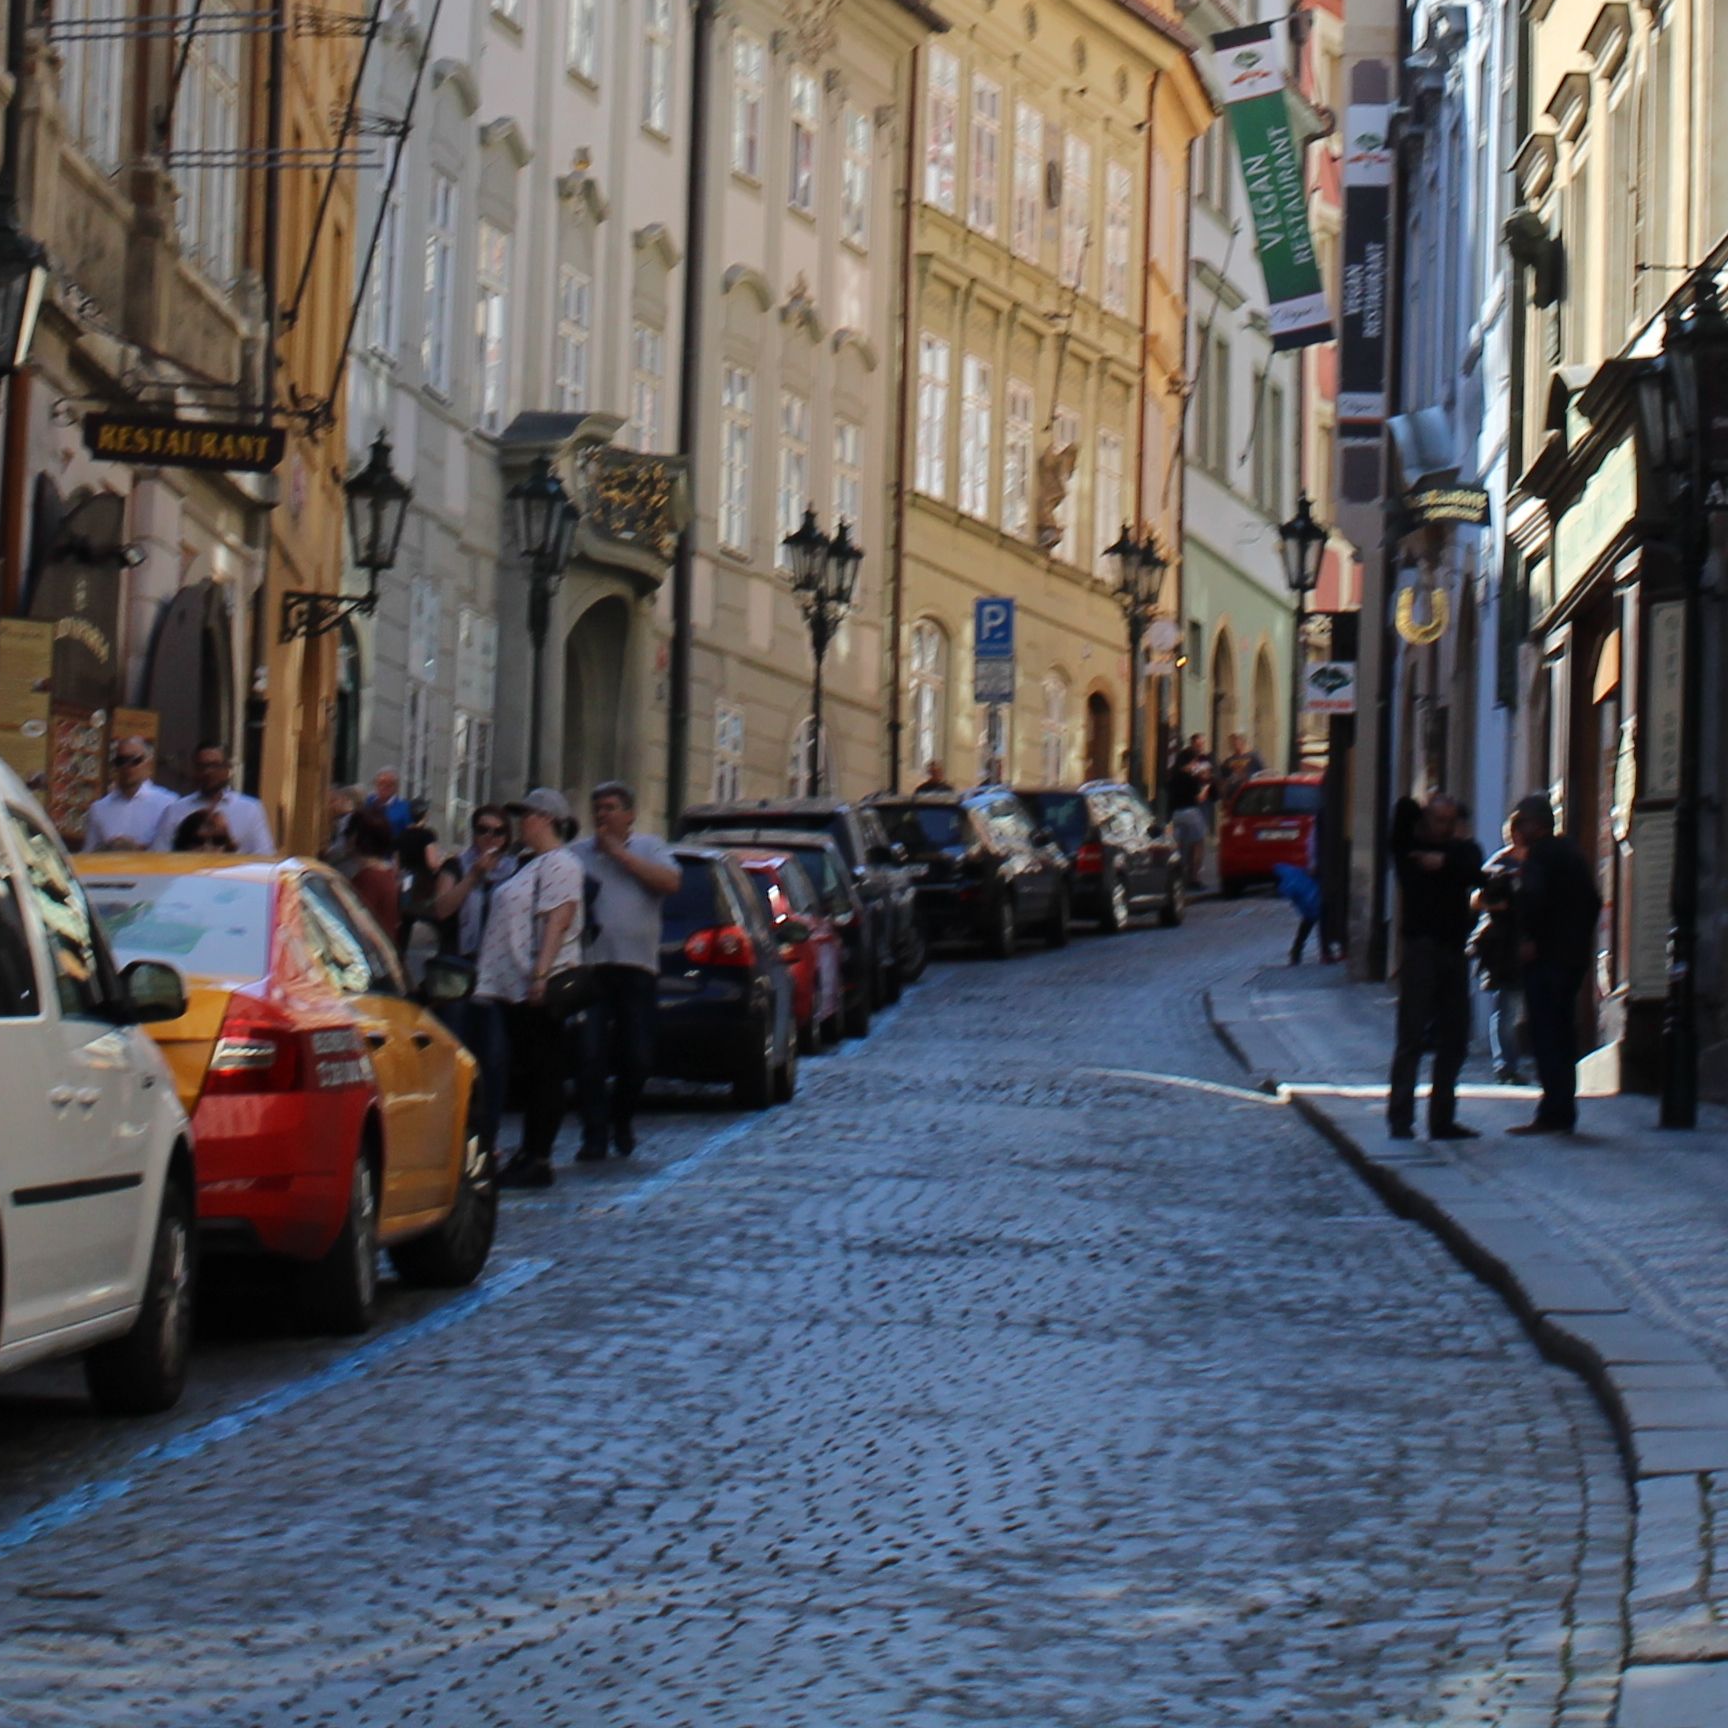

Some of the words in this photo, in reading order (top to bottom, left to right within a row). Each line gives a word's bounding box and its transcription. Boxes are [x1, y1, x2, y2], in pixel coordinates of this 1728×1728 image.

[1241, 155, 1287, 253] VEGAN
[1267, 124, 1314, 267] RESTAURANT
[98, 422, 271, 464] RESTAURANT
